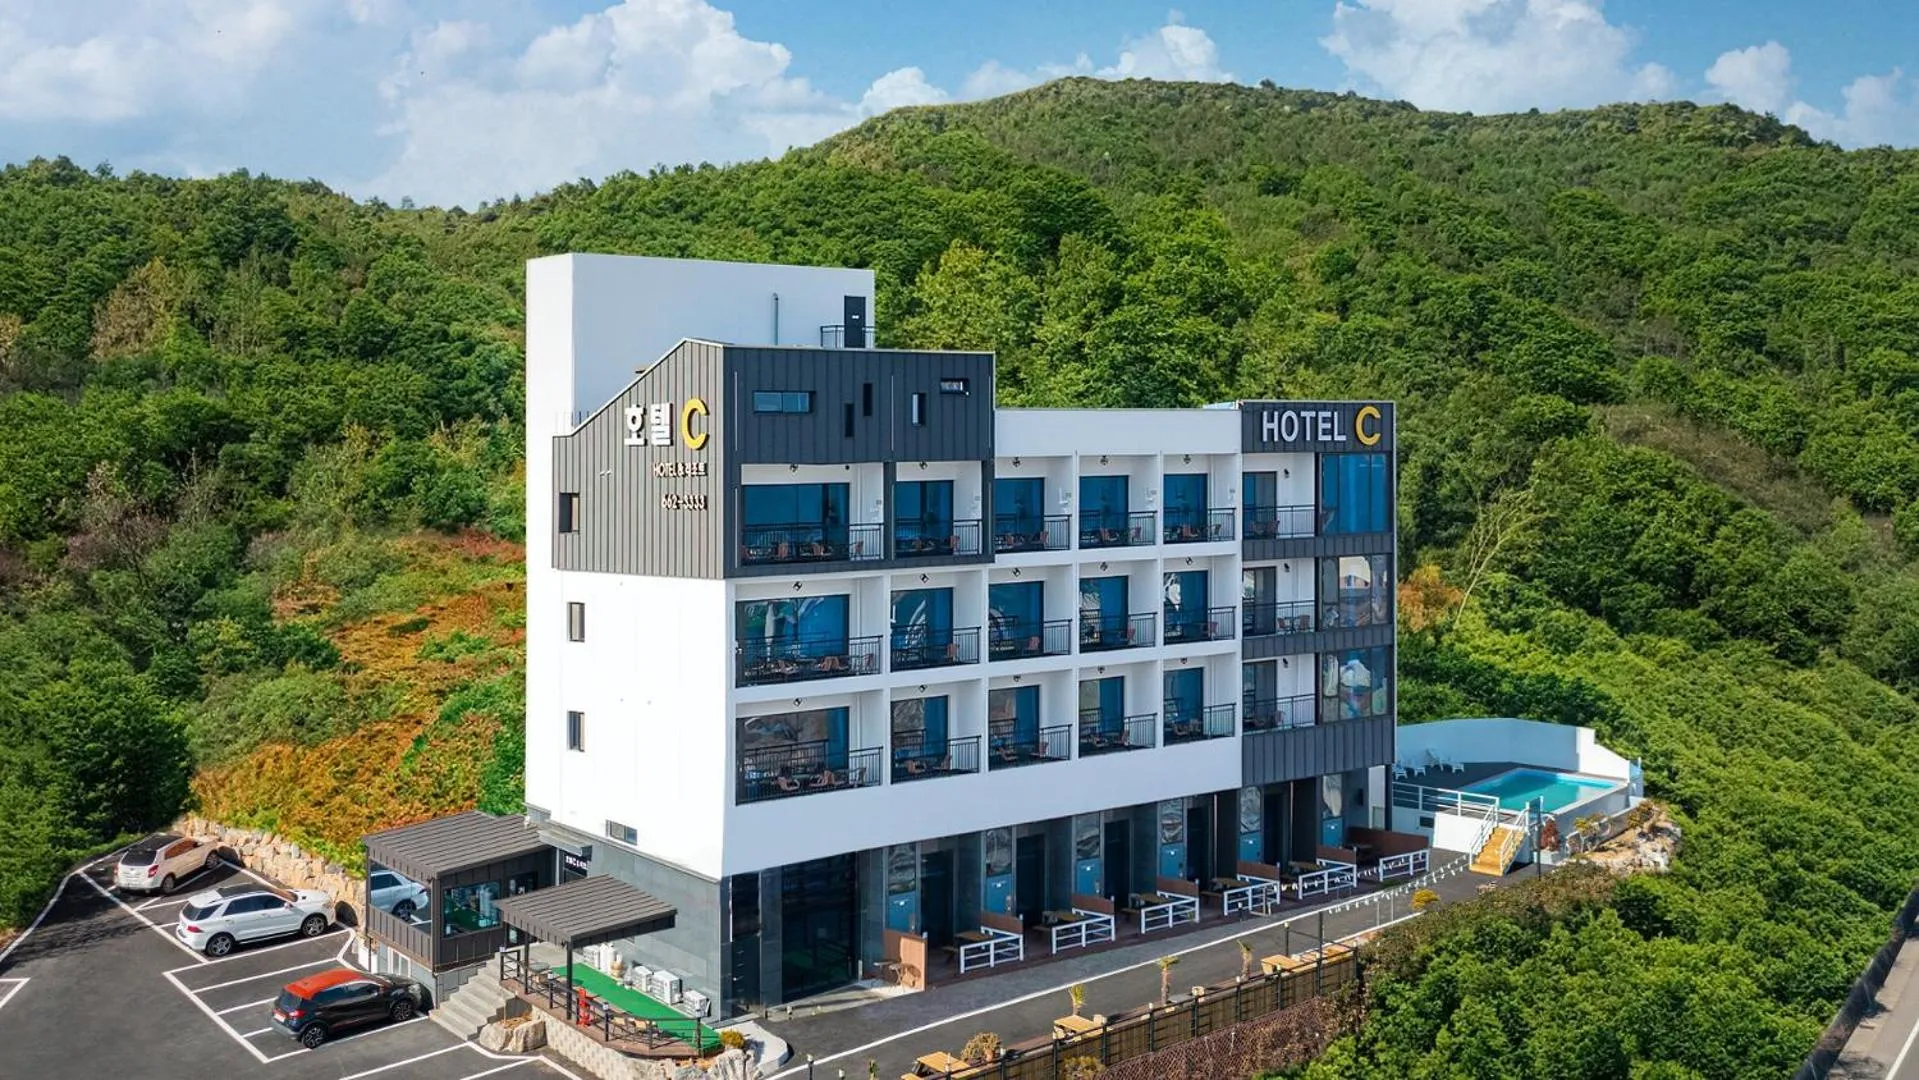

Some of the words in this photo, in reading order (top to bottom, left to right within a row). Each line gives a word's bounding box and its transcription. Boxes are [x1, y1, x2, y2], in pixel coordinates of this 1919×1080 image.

[624, 403, 672, 446] 호텔
[681, 397, 709, 450] C
[1262, 410, 1347, 442] HOTEL
[1355, 405, 1381, 446] C
[653, 462, 677, 477] HOTEL
